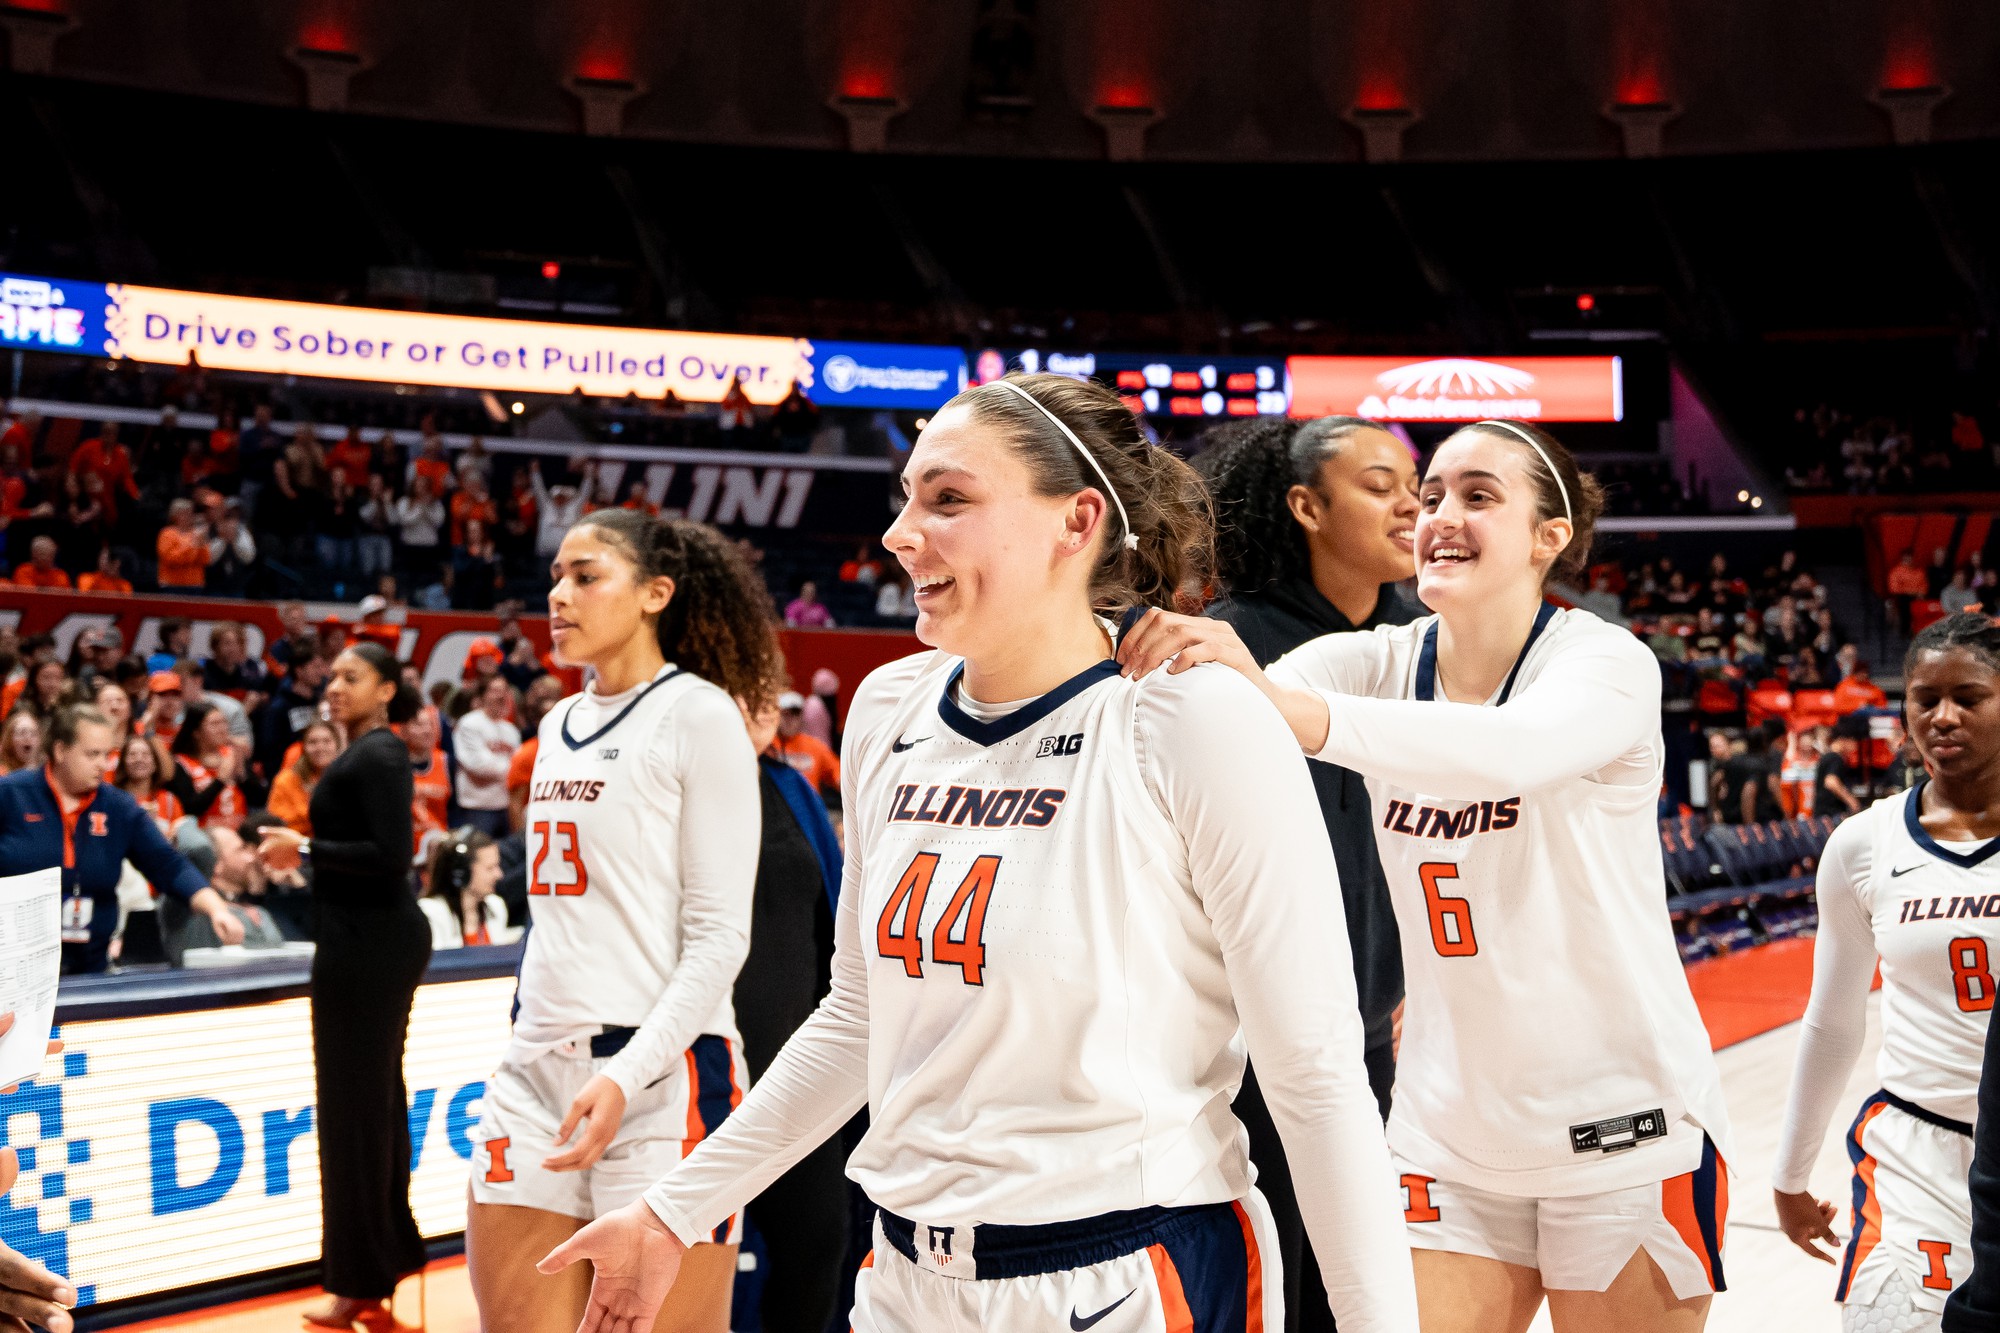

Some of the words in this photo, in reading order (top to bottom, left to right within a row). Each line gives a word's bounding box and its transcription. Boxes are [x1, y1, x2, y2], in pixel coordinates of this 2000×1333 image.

[145, 314, 256, 348] Drive
[274, 326, 393, 359] Sober
[408, 343, 446, 363] or
[461, 342, 527, 368] Get
[544, 347, 665, 377] Pulled
[680, 356, 779, 384] Over.
[887, 784, 1067, 827] ILLINOIS
[1383, 796, 1521, 840] ILINOIS
[528, 821, 588, 896] 23
[877, 851, 1002, 987] 44
[1418, 861, 1479, 958] 6
[1948, 936, 1997, 1013] 8
[148, 1081, 486, 1217] Drve
[1638, 1118, 1654, 1132] 46
[485, 1136, 514, 1183] I
[1400, 1173, 1441, 1223] I
[1917, 1239, 1952, 1291] I
